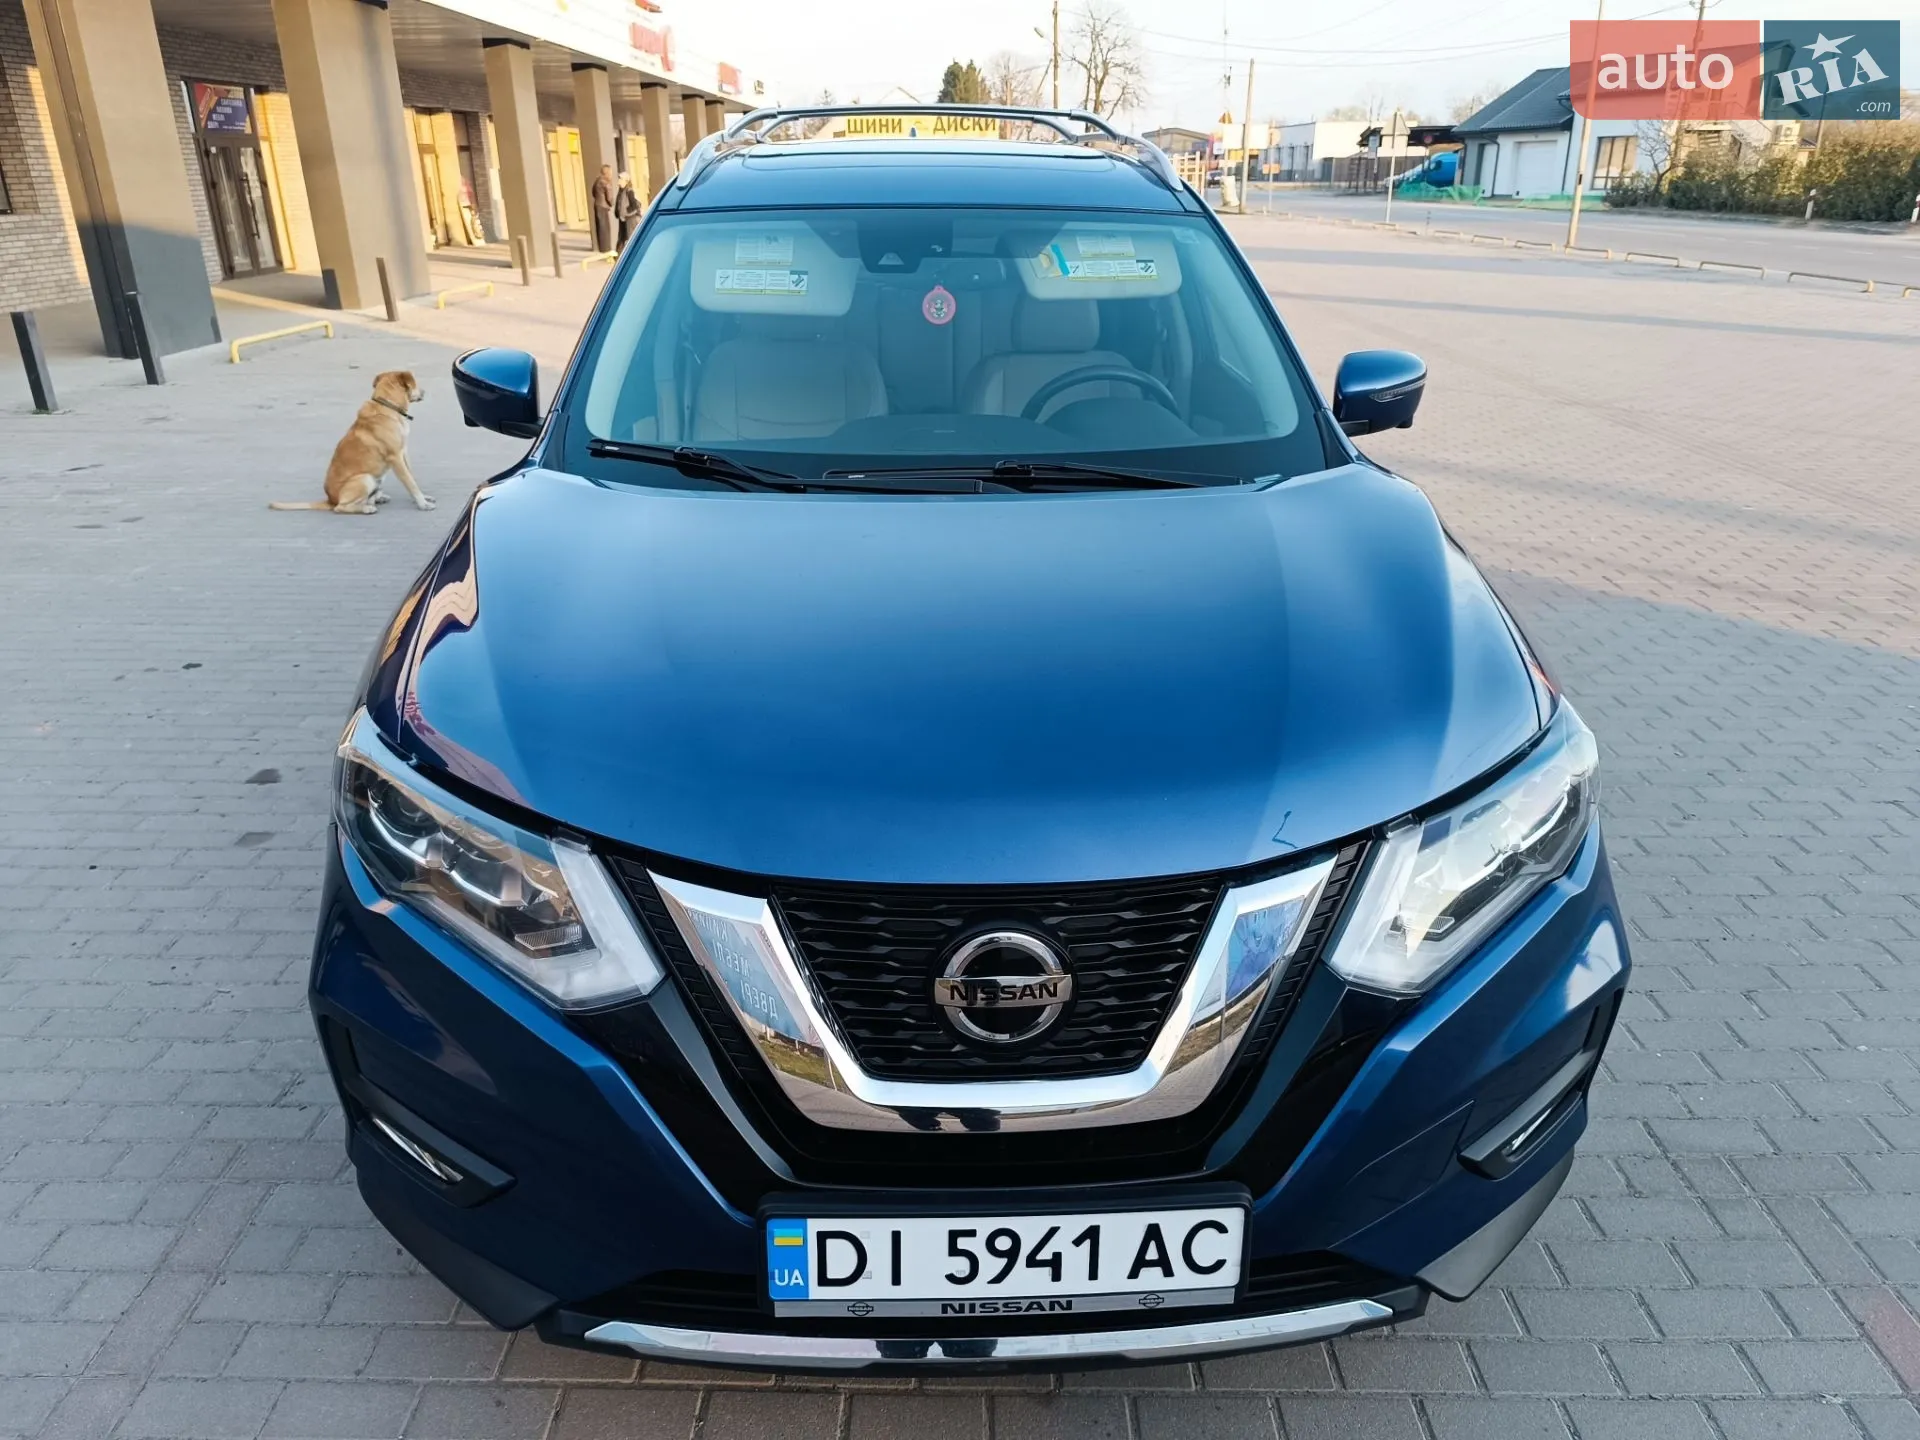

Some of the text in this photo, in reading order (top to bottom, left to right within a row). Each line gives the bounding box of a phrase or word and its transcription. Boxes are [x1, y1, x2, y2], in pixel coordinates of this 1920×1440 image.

[847, 116, 996, 134] ШИНИ ДИСКИ
[950, 982, 1058, 1001] NISSAN
[816, 1219, 1229, 1287] DI 5941 AC
[774, 1268, 804, 1287] UA
[941, 1299, 1073, 1315] NISSAN
